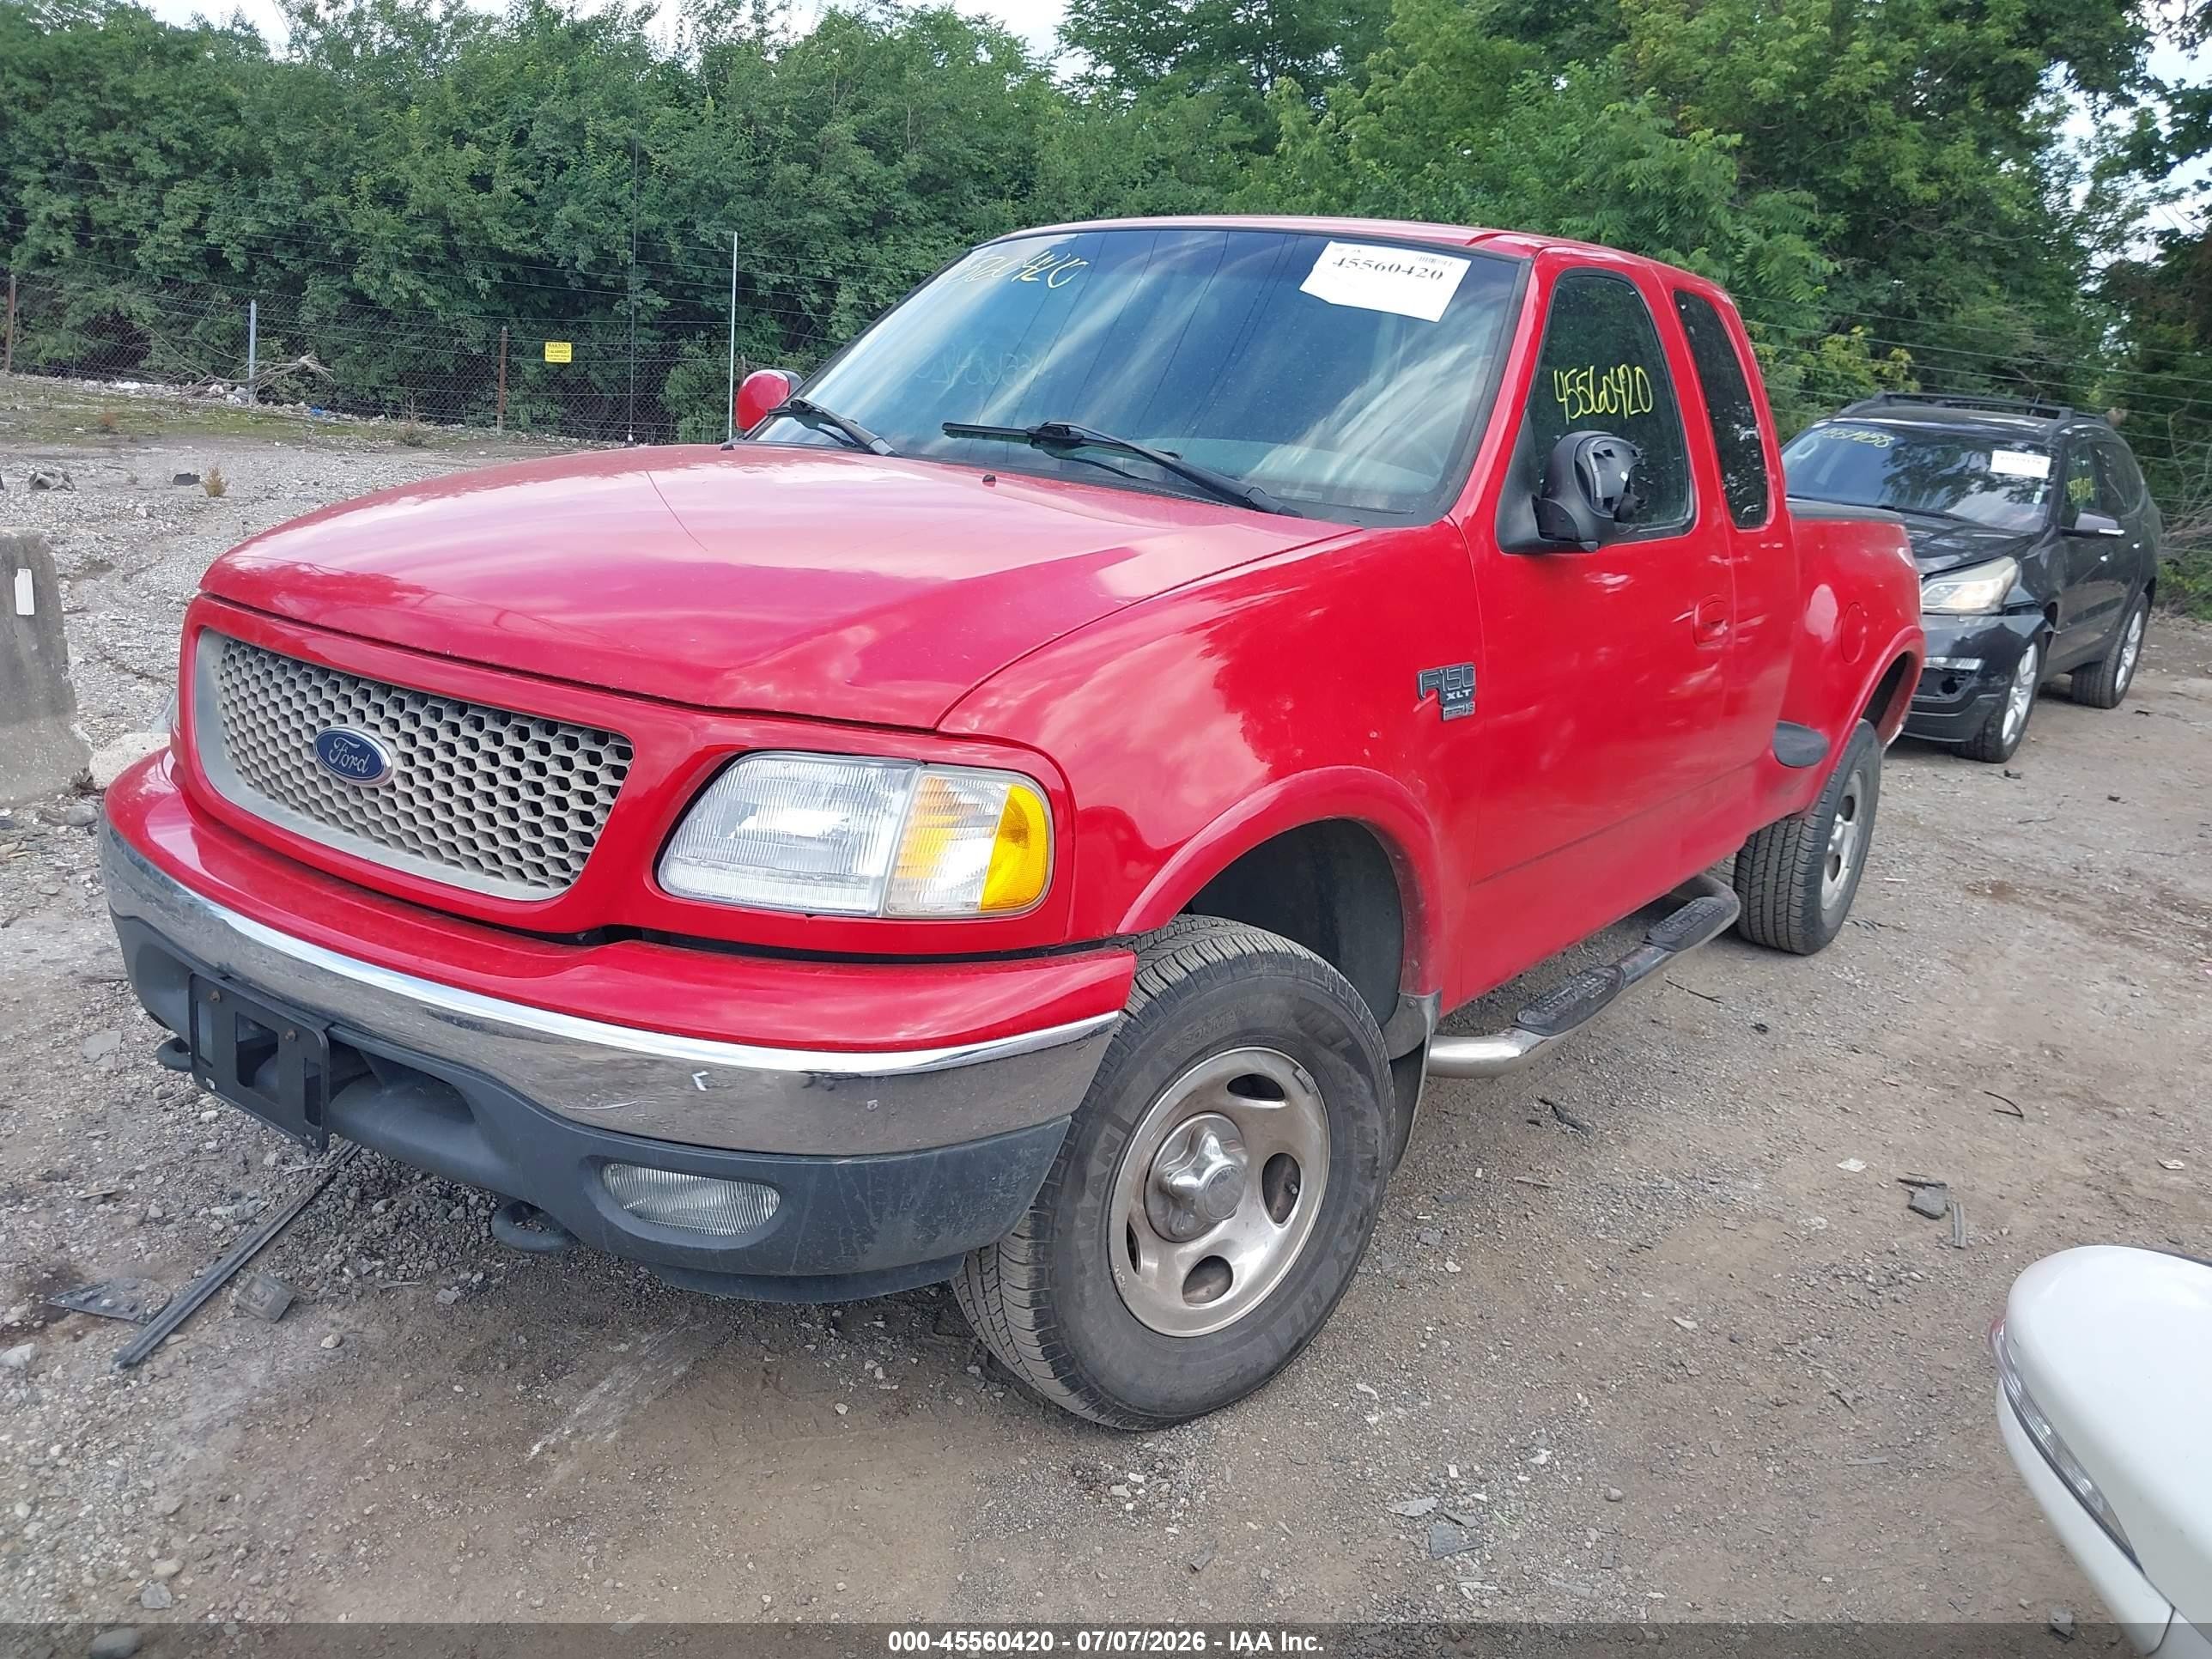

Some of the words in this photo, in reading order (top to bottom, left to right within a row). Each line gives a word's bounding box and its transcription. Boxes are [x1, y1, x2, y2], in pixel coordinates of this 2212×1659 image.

[1332, 257, 1443, 282] 45560420
[1553, 363, 1654, 426] 45560420
[1446, 689, 1472, 701] XLT
[329, 737, 371, 774] Ford
